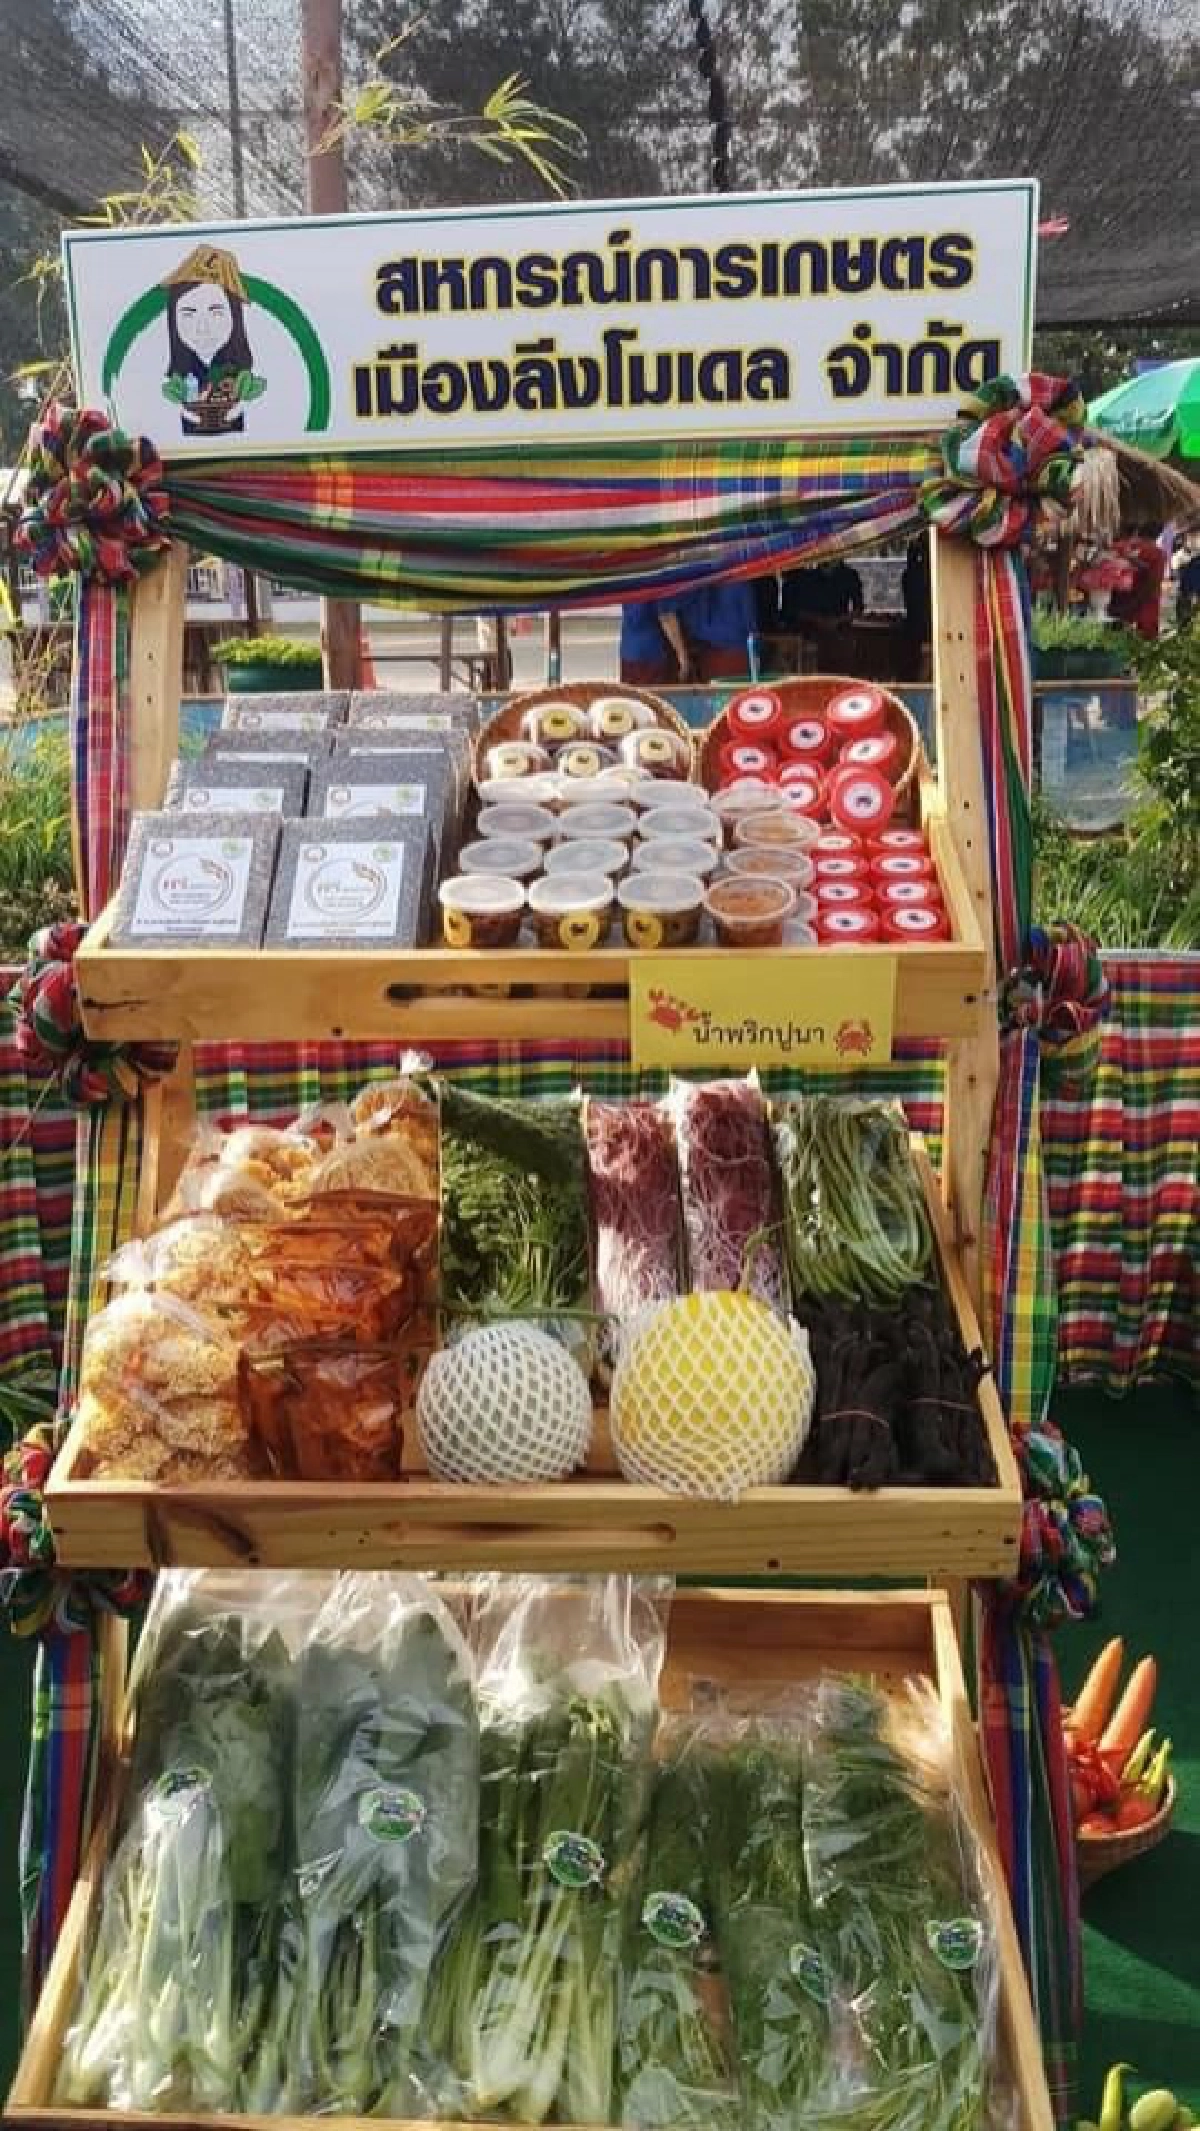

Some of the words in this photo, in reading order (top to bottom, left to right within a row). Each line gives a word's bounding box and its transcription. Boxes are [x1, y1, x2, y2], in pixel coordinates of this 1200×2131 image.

[375, 229, 975, 314] สหกรณ์การเกษตร
[352, 328, 791, 418] เมืองลีงโมเดล
[825, 320, 1001, 399] จำกัด
[692, 1010, 825, 1052] น้ำพริกปูนา
